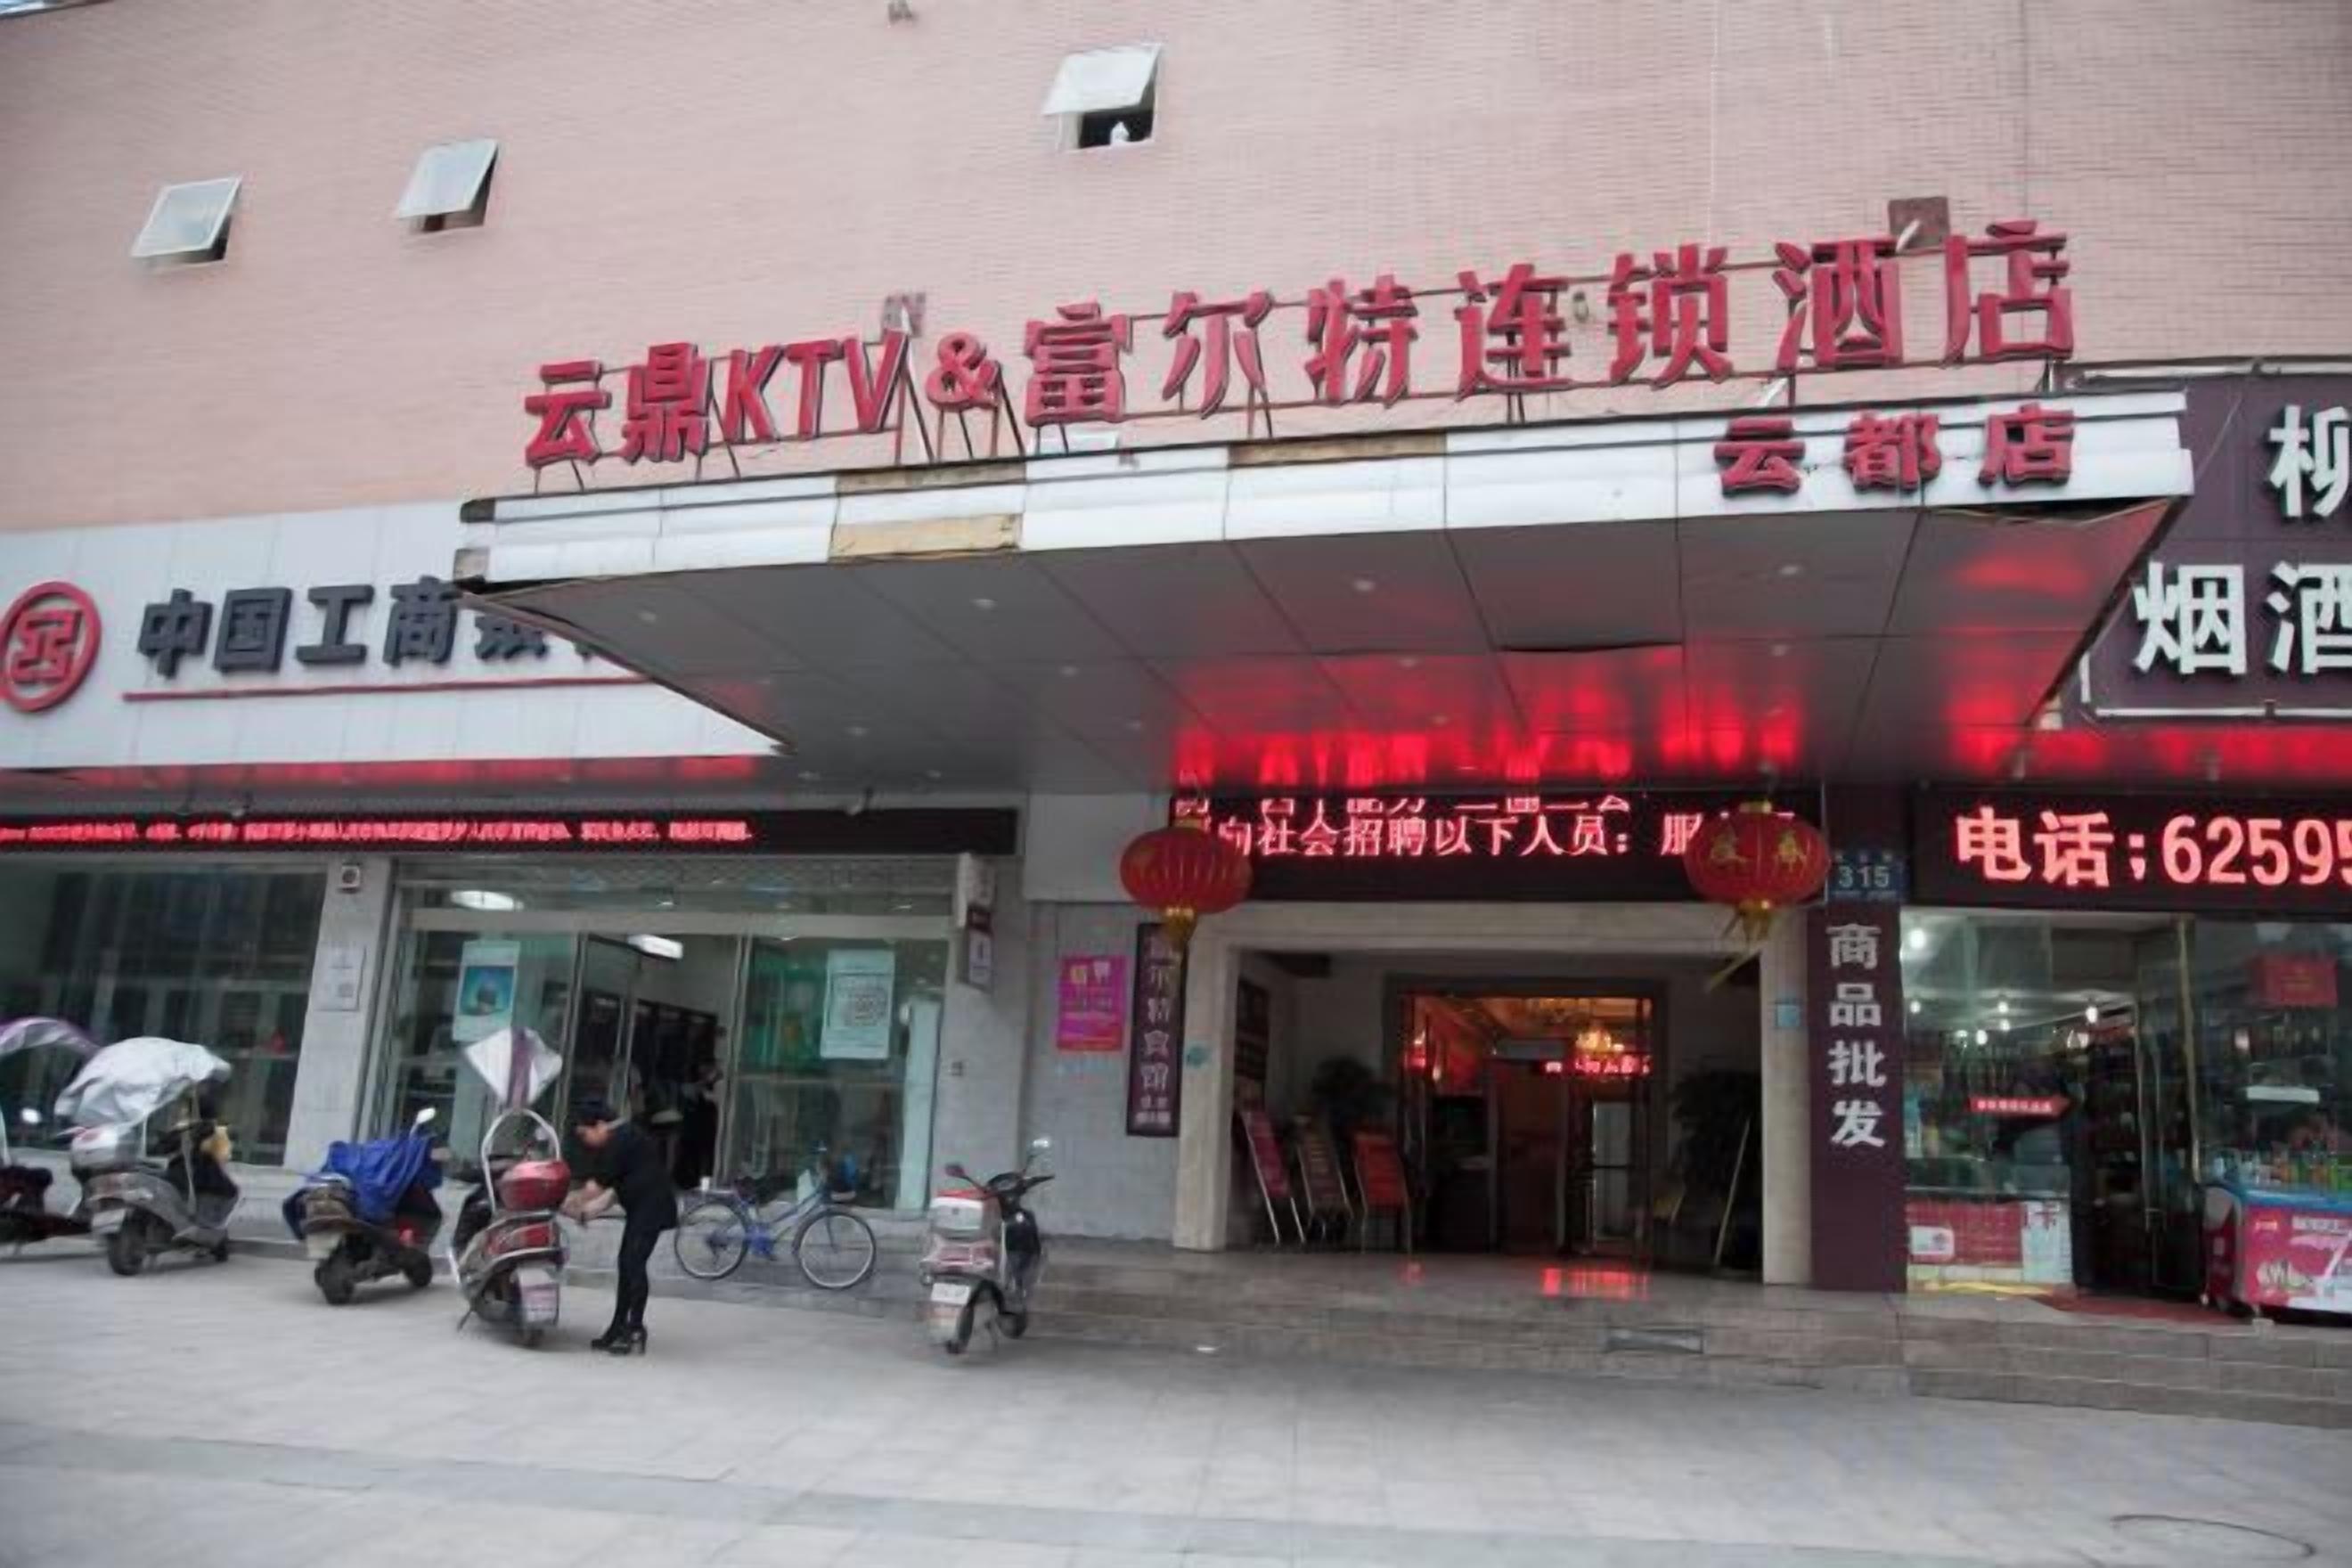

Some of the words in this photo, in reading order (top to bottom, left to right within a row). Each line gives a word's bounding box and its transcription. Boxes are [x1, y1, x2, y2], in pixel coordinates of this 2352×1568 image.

[1712, 402, 2075, 496] 云都店
[137, 575, 597, 679] 中国工商
[2133, 560, 2352, 675] 烟酒
[1838, 865, 1890, 888] 315
[1825, 923, 1887, 1147] 商品批发
